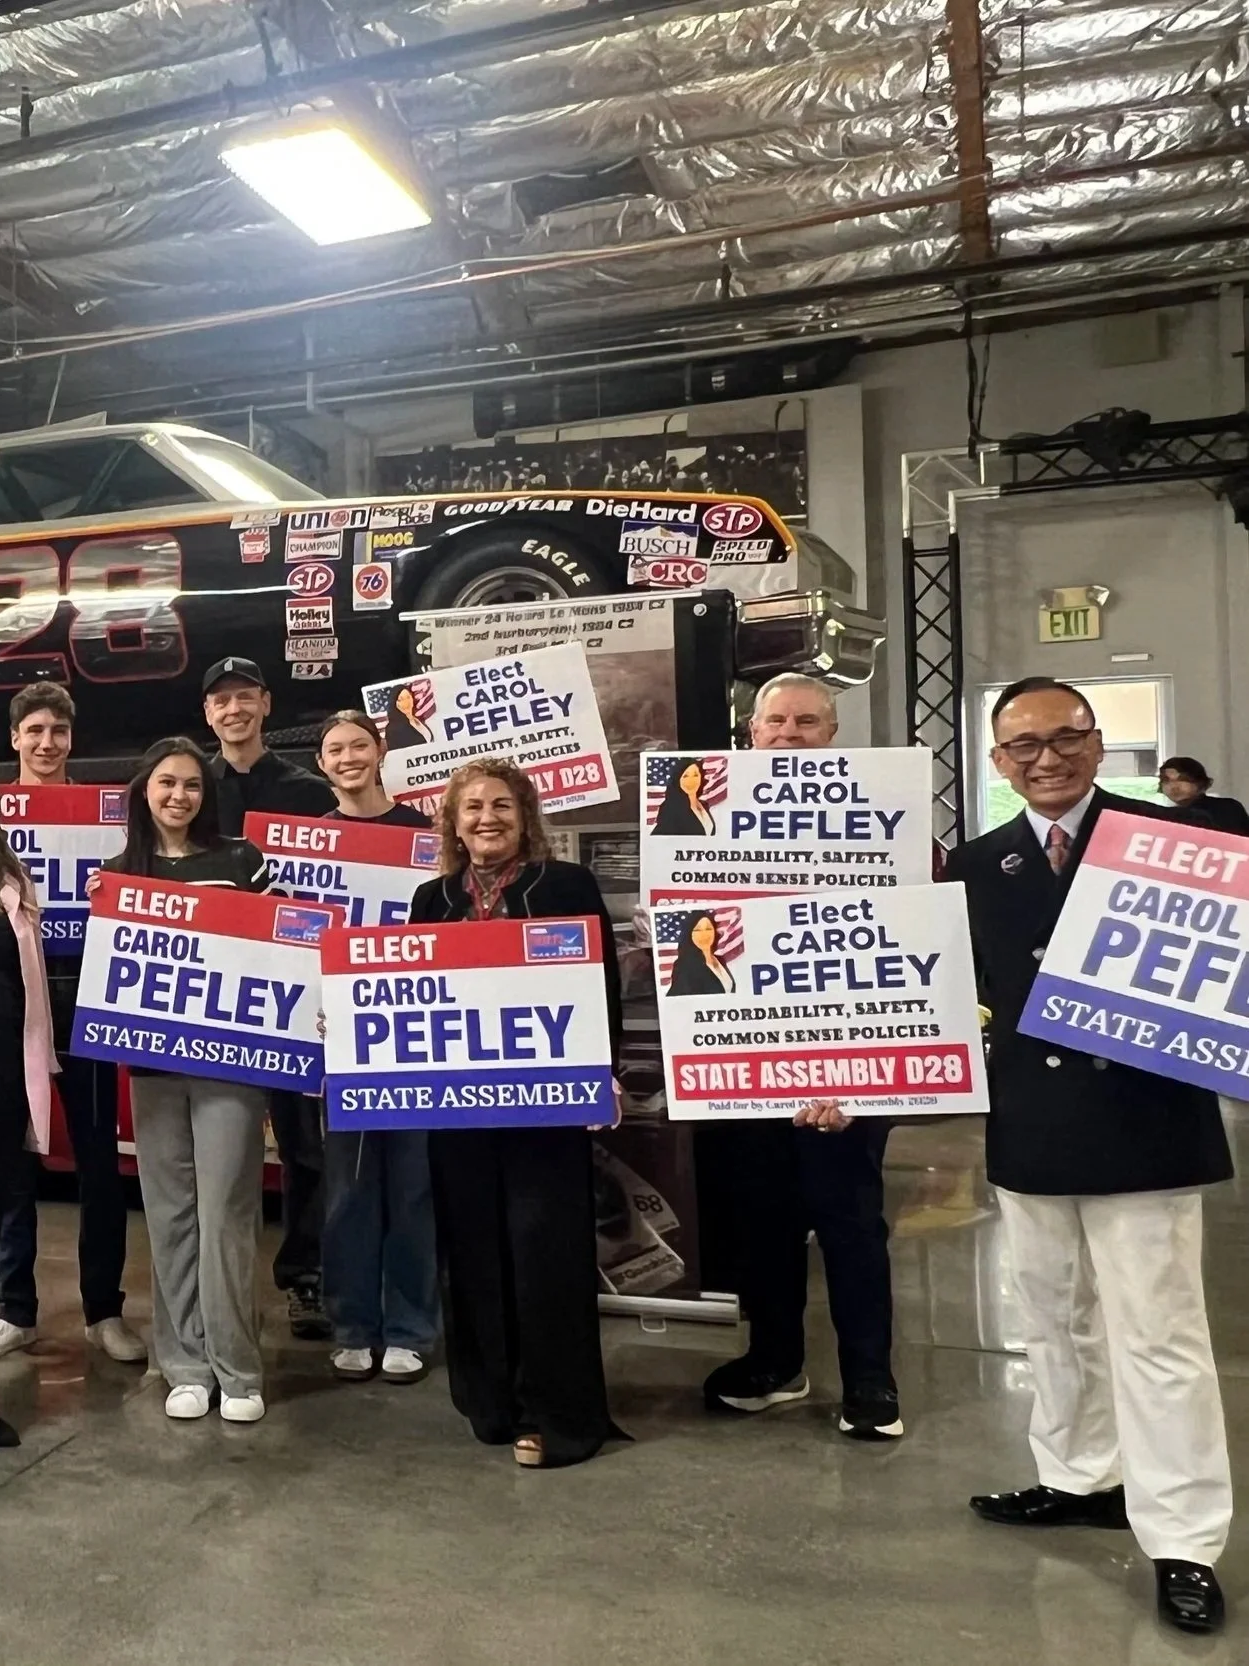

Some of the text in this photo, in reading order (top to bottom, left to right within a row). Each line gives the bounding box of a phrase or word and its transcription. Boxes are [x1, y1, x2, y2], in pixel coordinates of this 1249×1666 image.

[444, 496, 573, 516] GOODYEAR
[586, 499, 698, 523] DieHard
[707, 507, 760, 531] STP
[290, 539, 338, 553] CHAMPION
[374, 532, 414, 547] MOOG
[623, 536, 691, 556] BUSCH
[715, 540, 768, 551] SPEED
[521, 539, 591, 587] EAGLE
[711, 552, 746, 561] PRO
[293, 566, 328, 591] STP
[361, 573, 384, 591] 76
[648, 562, 708, 584] CRC
[290, 609, 330, 623] Holley
[1050, 608, 1090, 638] EXIT
[464, 661, 525, 687] Elect
[455, 678, 545, 710] CAROL
[443, 692, 574, 741] PEFLEY
[406, 726, 575, 769] AFFORDABILITY, SAFETY,
[518, 742, 581, 763] POLICIES
[561, 762, 601, 789] D28
[771, 756, 849, 778] Elect
[752, 781, 870, 805] CAROL
[266, 823, 342, 852] ELECT
[730, 810, 906, 841] PEFLEY
[674, 851, 894, 867] AFFORDABILITY, SAFETY,
[1122, 831, 1249, 884] ELECT
[266, 859, 348, 890] CAROL
[671, 871, 898, 887] COMMON SENSE POLICIES
[117, 887, 200, 922] ELECT
[789, 899, 874, 927] Elect
[1108, 879, 1241, 940] CAROL
[112, 925, 205, 965] CAROL
[349, 934, 437, 965] ELECT
[771, 926, 899, 956] CAROL
[751, 952, 942, 996] PEFLEY
[103, 955, 307, 1032] PEFLEY
[352, 975, 456, 1008] CAROL
[694, 999, 935, 1024] AFFORDABILITY, SAFETY,
[1041, 994, 1162, 1049] STATE
[354, 1004, 575, 1065] PEFLEY
[692, 1023, 941, 1048] COMMON SENSE POLICIES
[83, 1022, 315, 1078] STATE ASSEMBLY
[679, 1054, 964, 1092] STATE ASSEMBLY D28
[341, 1081, 602, 1111] STATE ASSEMBLY
